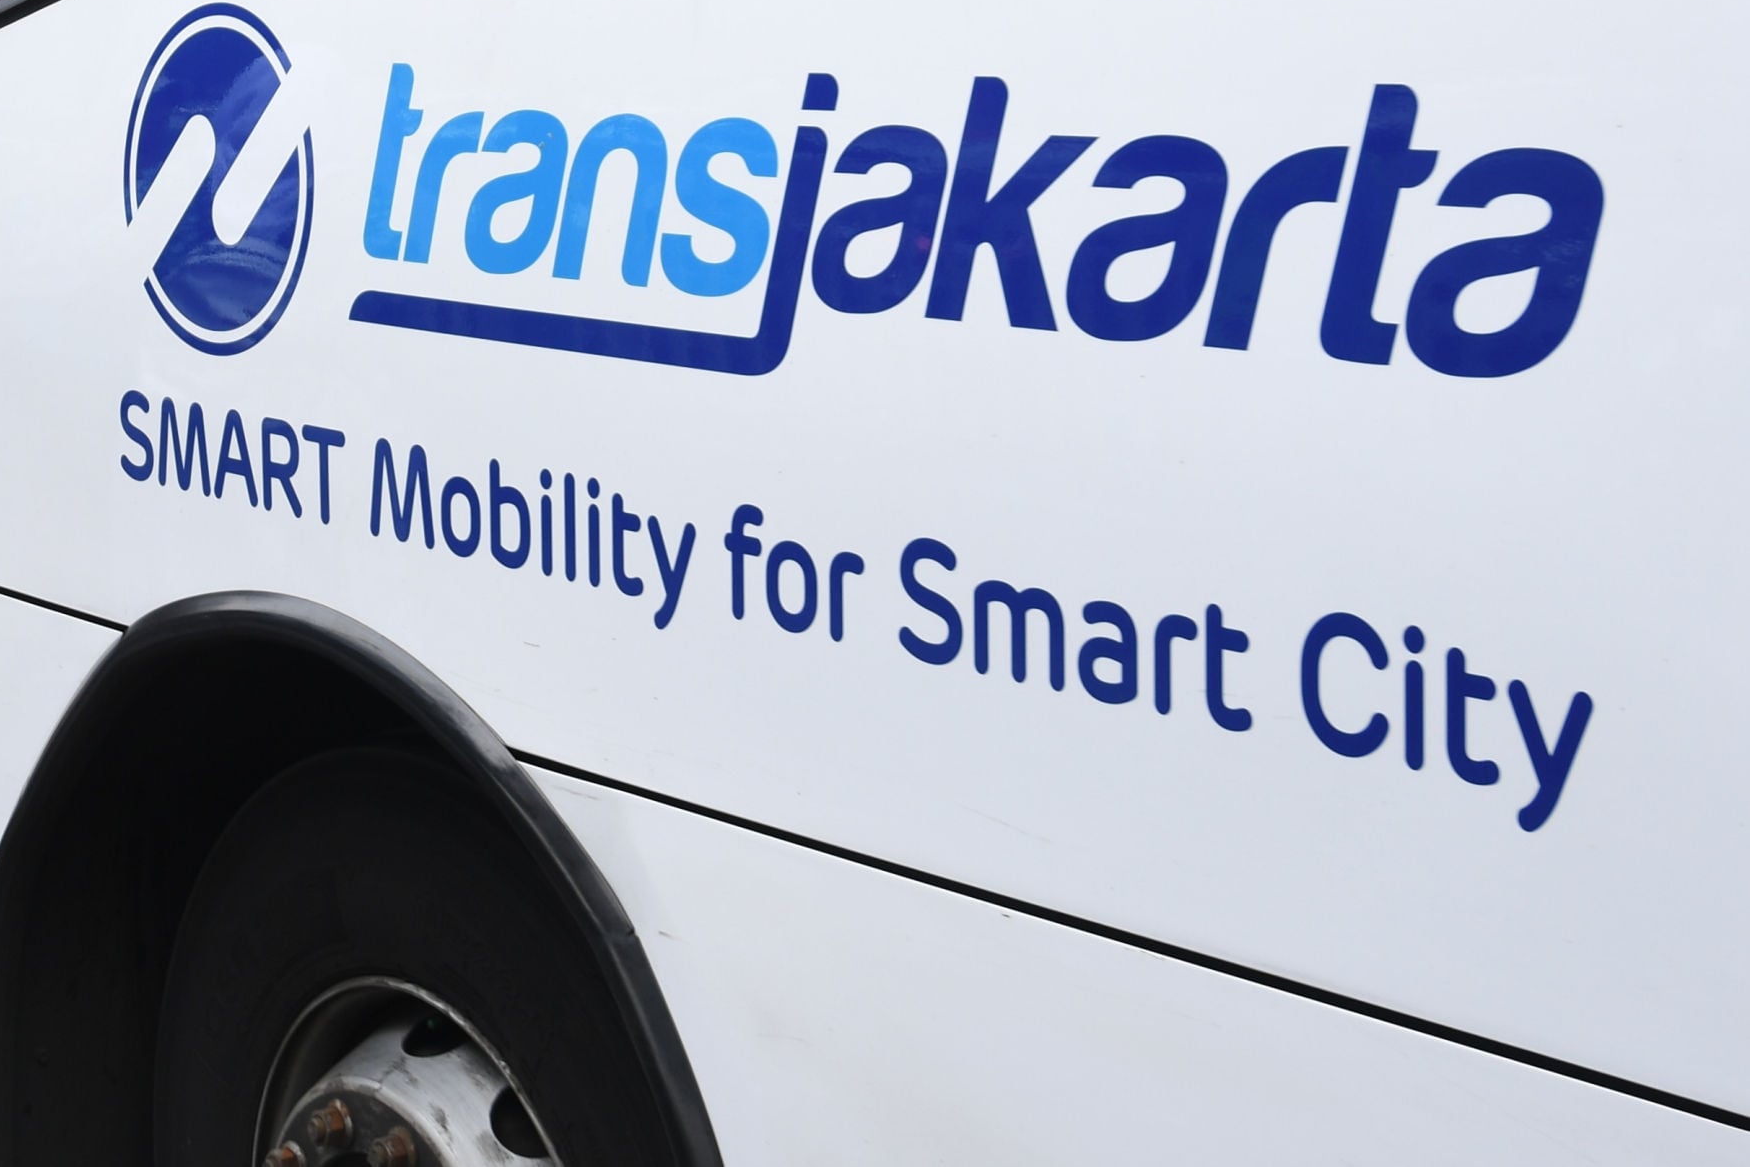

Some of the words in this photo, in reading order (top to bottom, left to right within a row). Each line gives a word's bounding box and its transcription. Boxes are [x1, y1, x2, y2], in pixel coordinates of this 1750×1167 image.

[350, 63, 1605, 378] transjakarta
[120, 390, 346, 525] SMART
[370, 437, 696, 630] Mobility
[723, 503, 865, 642] for
[899, 537, 1253, 732] Smart
[1300, 612, 1594, 833] City
